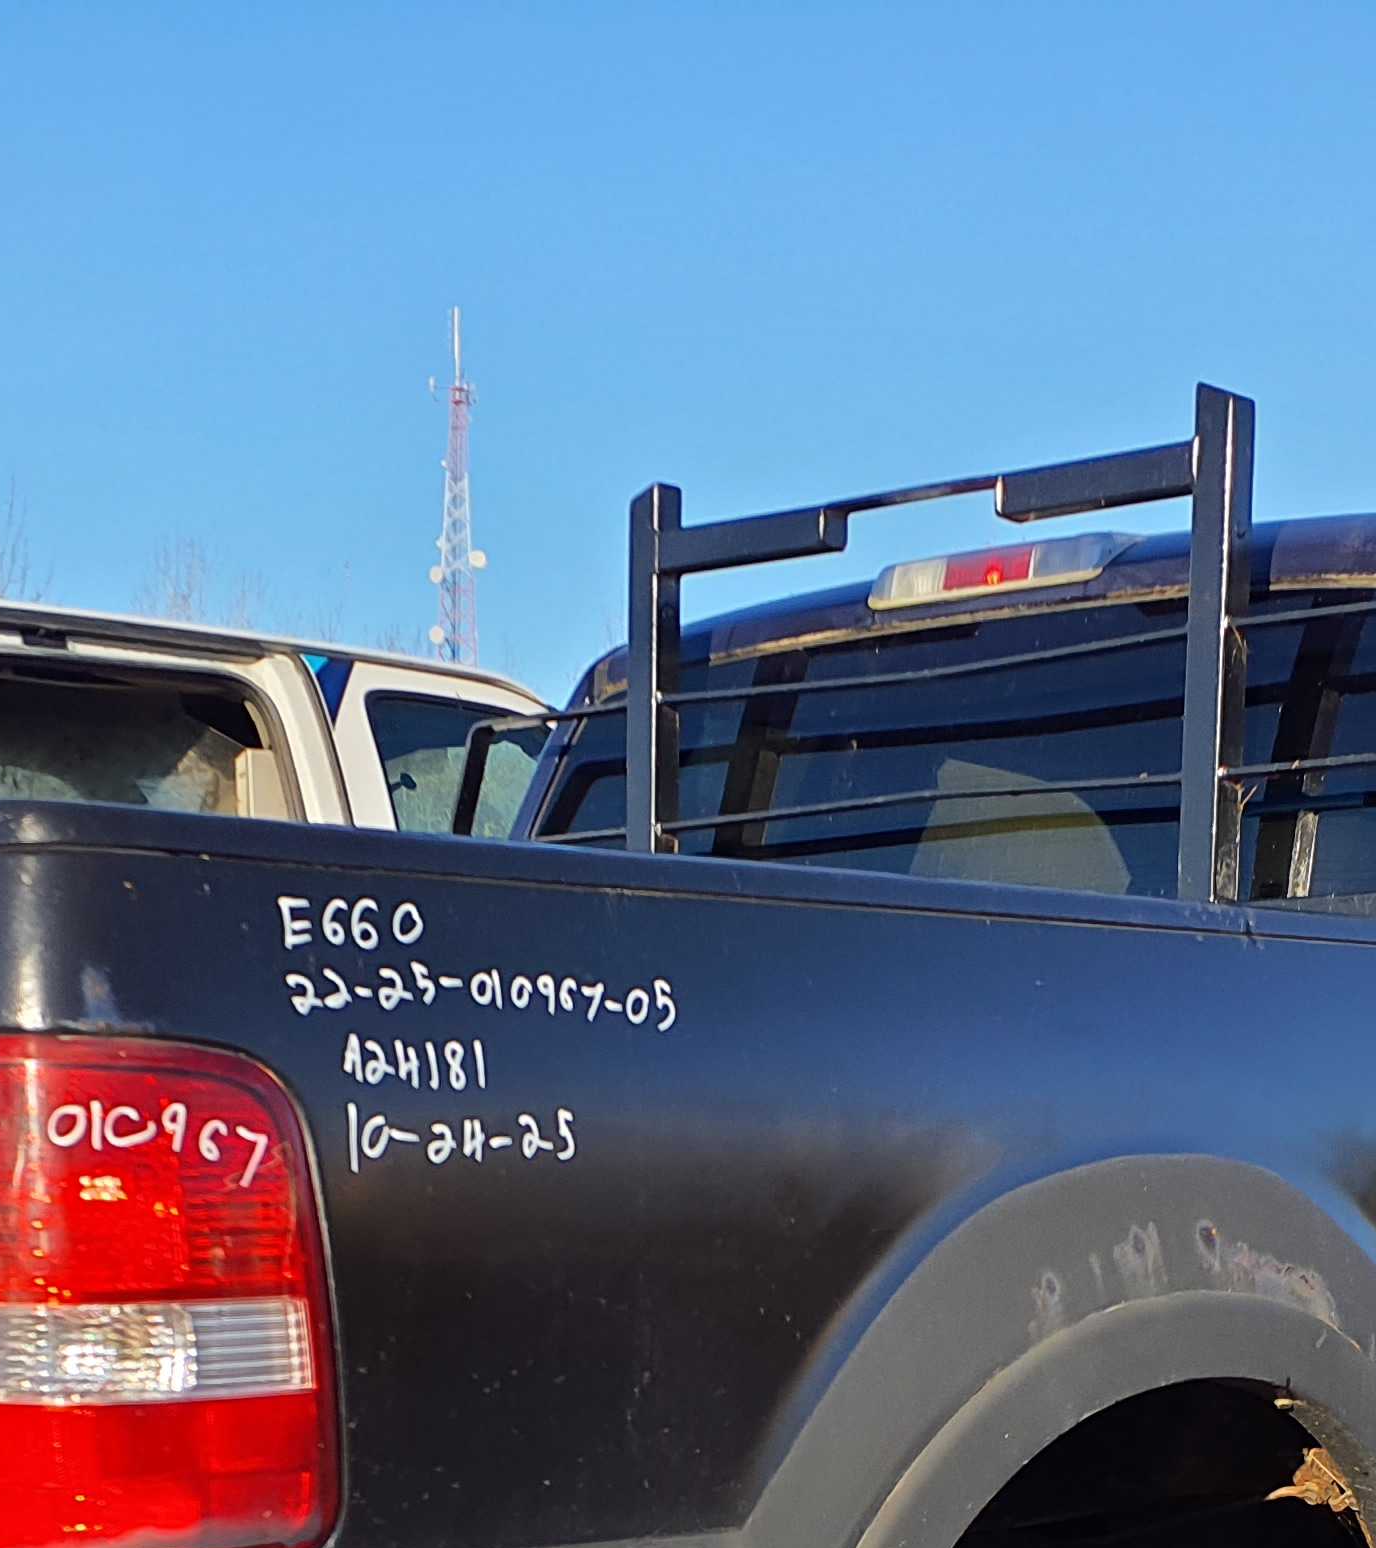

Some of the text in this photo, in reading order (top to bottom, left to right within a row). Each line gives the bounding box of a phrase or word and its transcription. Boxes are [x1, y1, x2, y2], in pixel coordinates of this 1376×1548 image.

[277, 896, 423, 950] E660
[285, 961, 677, 1032] 22-25-010967-05
[343, 1033, 486, 1090] A24181
[347, 1102, 576, 1174] 10-24-25
